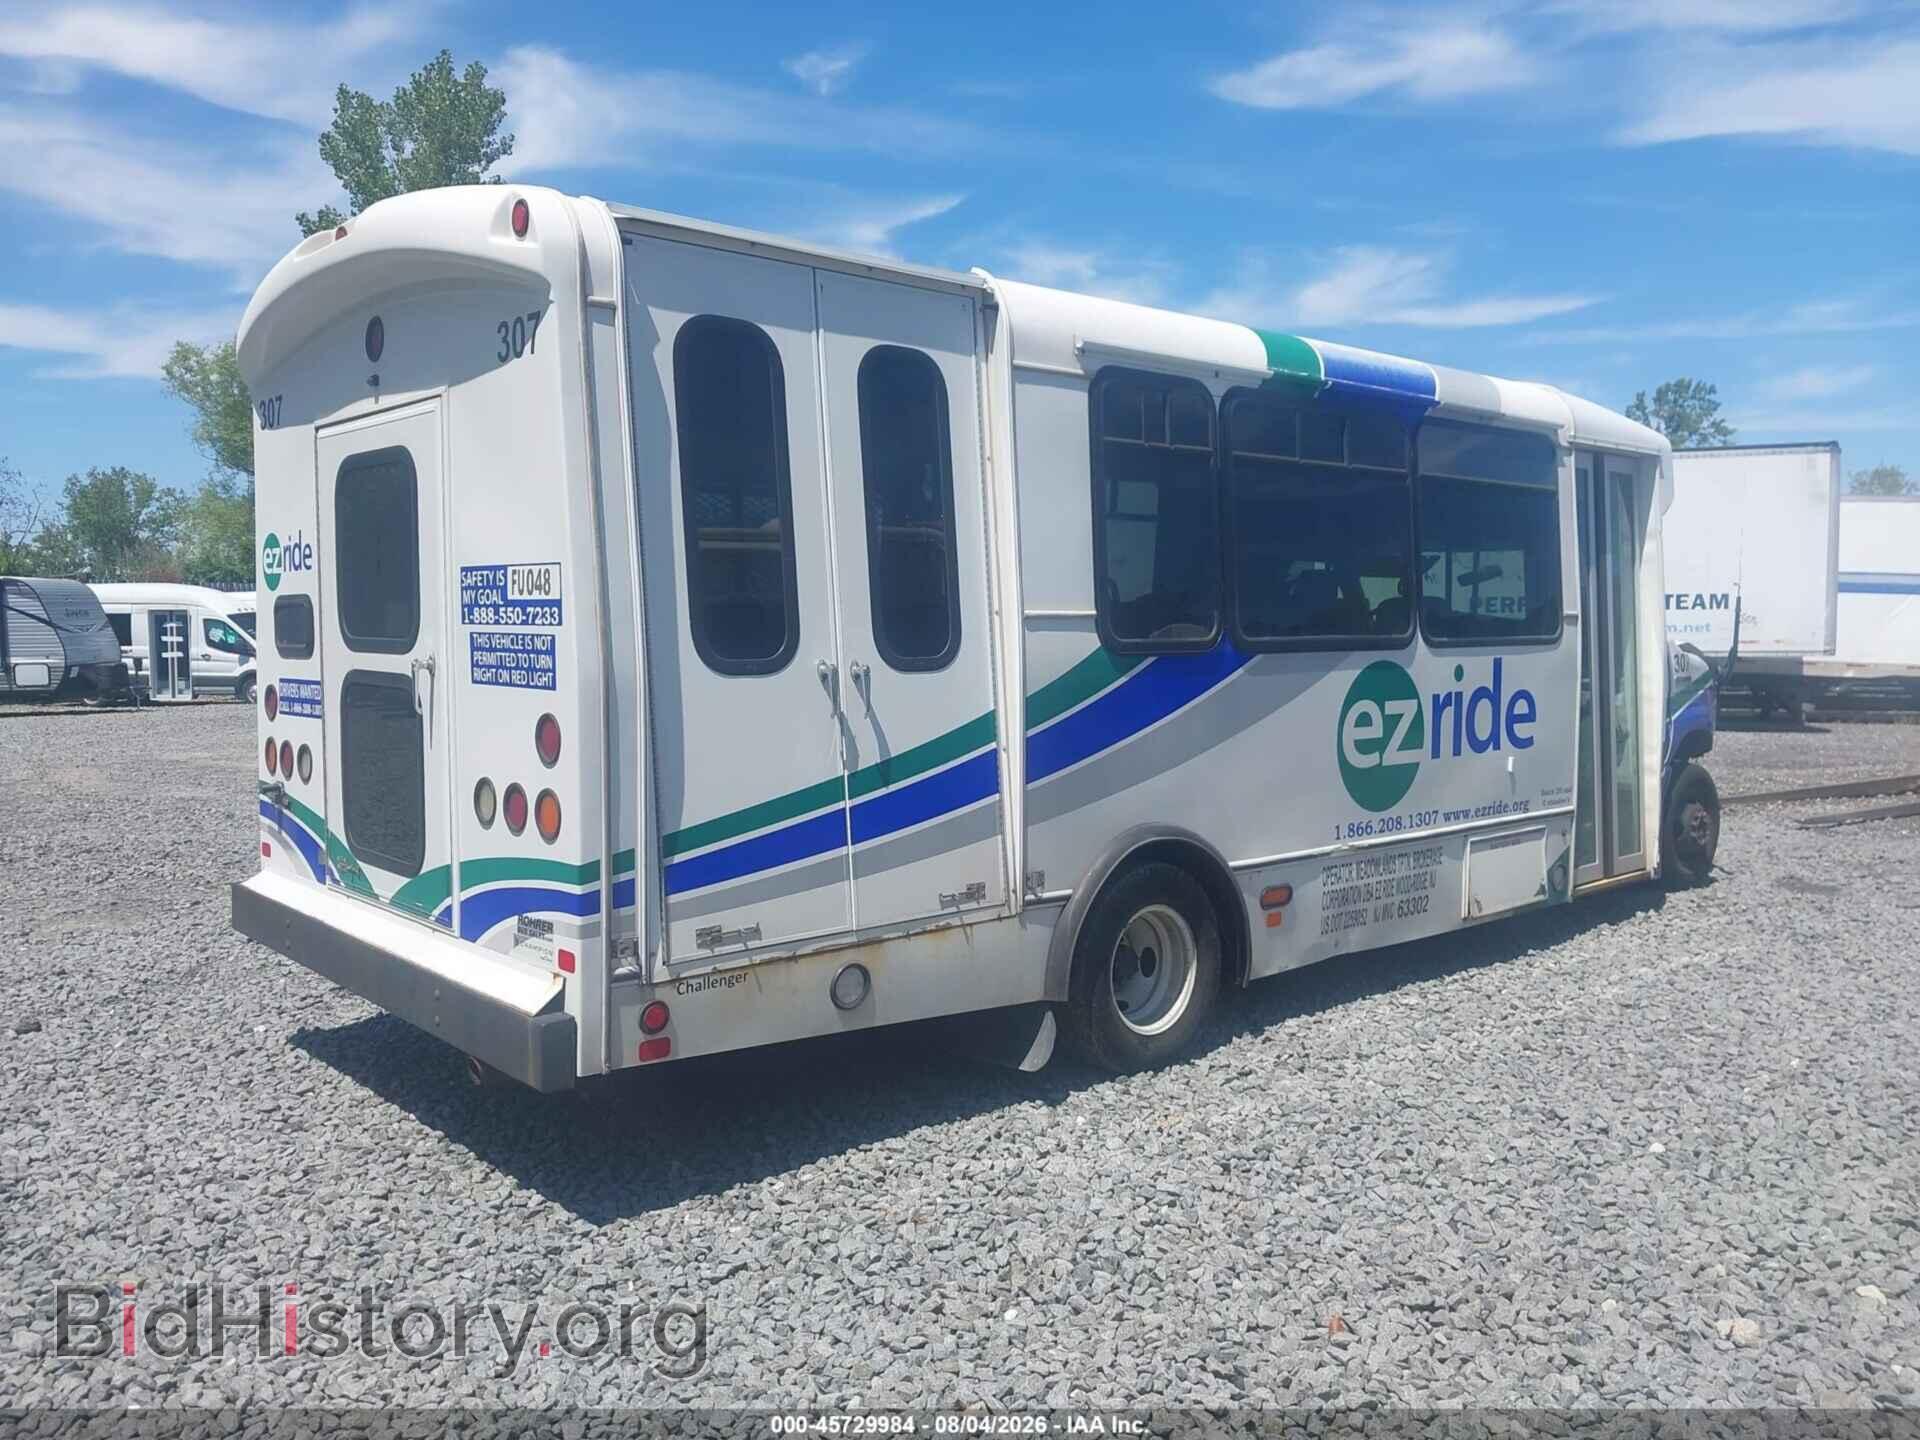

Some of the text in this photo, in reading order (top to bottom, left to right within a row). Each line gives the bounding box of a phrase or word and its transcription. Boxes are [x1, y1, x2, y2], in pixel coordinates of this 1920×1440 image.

[497, 309, 541, 364] 307
[259, 394, 283, 431] 307
[461, 570, 506, 587] SAFETY IS
[511, 568, 552, 597] FU048
[463, 589, 505, 605] MY GOAL
[1665, 593, 1730, 610] TEAM
[463, 606, 559, 625] 1-888-550-7233
[472, 633, 552, 651] THIS VEHICLE IS NOT
[473, 651, 553, 670] PERMITTED TO TURN
[473, 667, 554, 687] RIGHT ON RED LIGHT
[1334, 799, 1530, 841] 1.866.208.1307 www.ezride.org
[1396, 894, 1430, 918] 63302
[676, 972, 749, 996] Challenger
